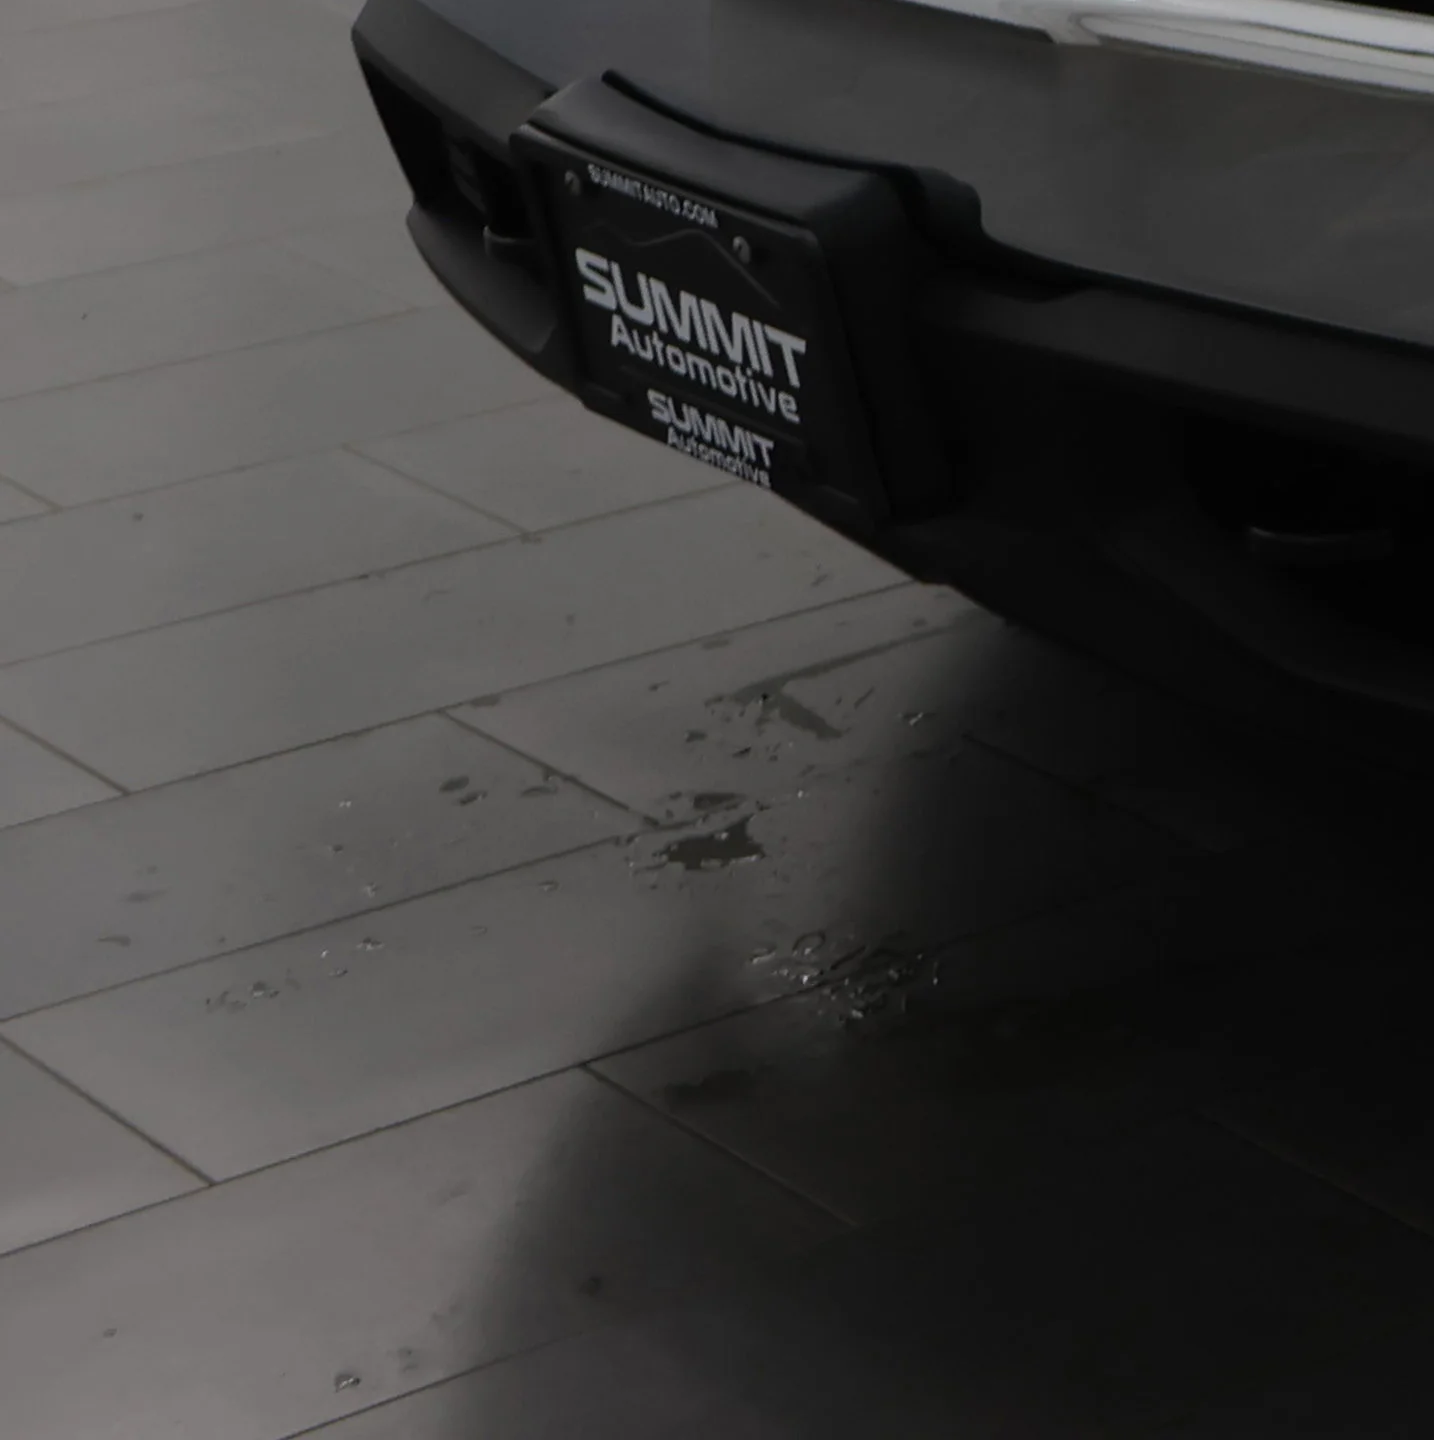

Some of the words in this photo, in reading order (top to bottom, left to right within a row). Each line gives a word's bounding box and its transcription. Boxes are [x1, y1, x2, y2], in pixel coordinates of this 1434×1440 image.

[575, 247, 806, 388] SUMMIT
[610, 314, 800, 424] Automotive
[646, 387, 774, 468] SUMMIT
[666, 426, 772, 489] Automotive
